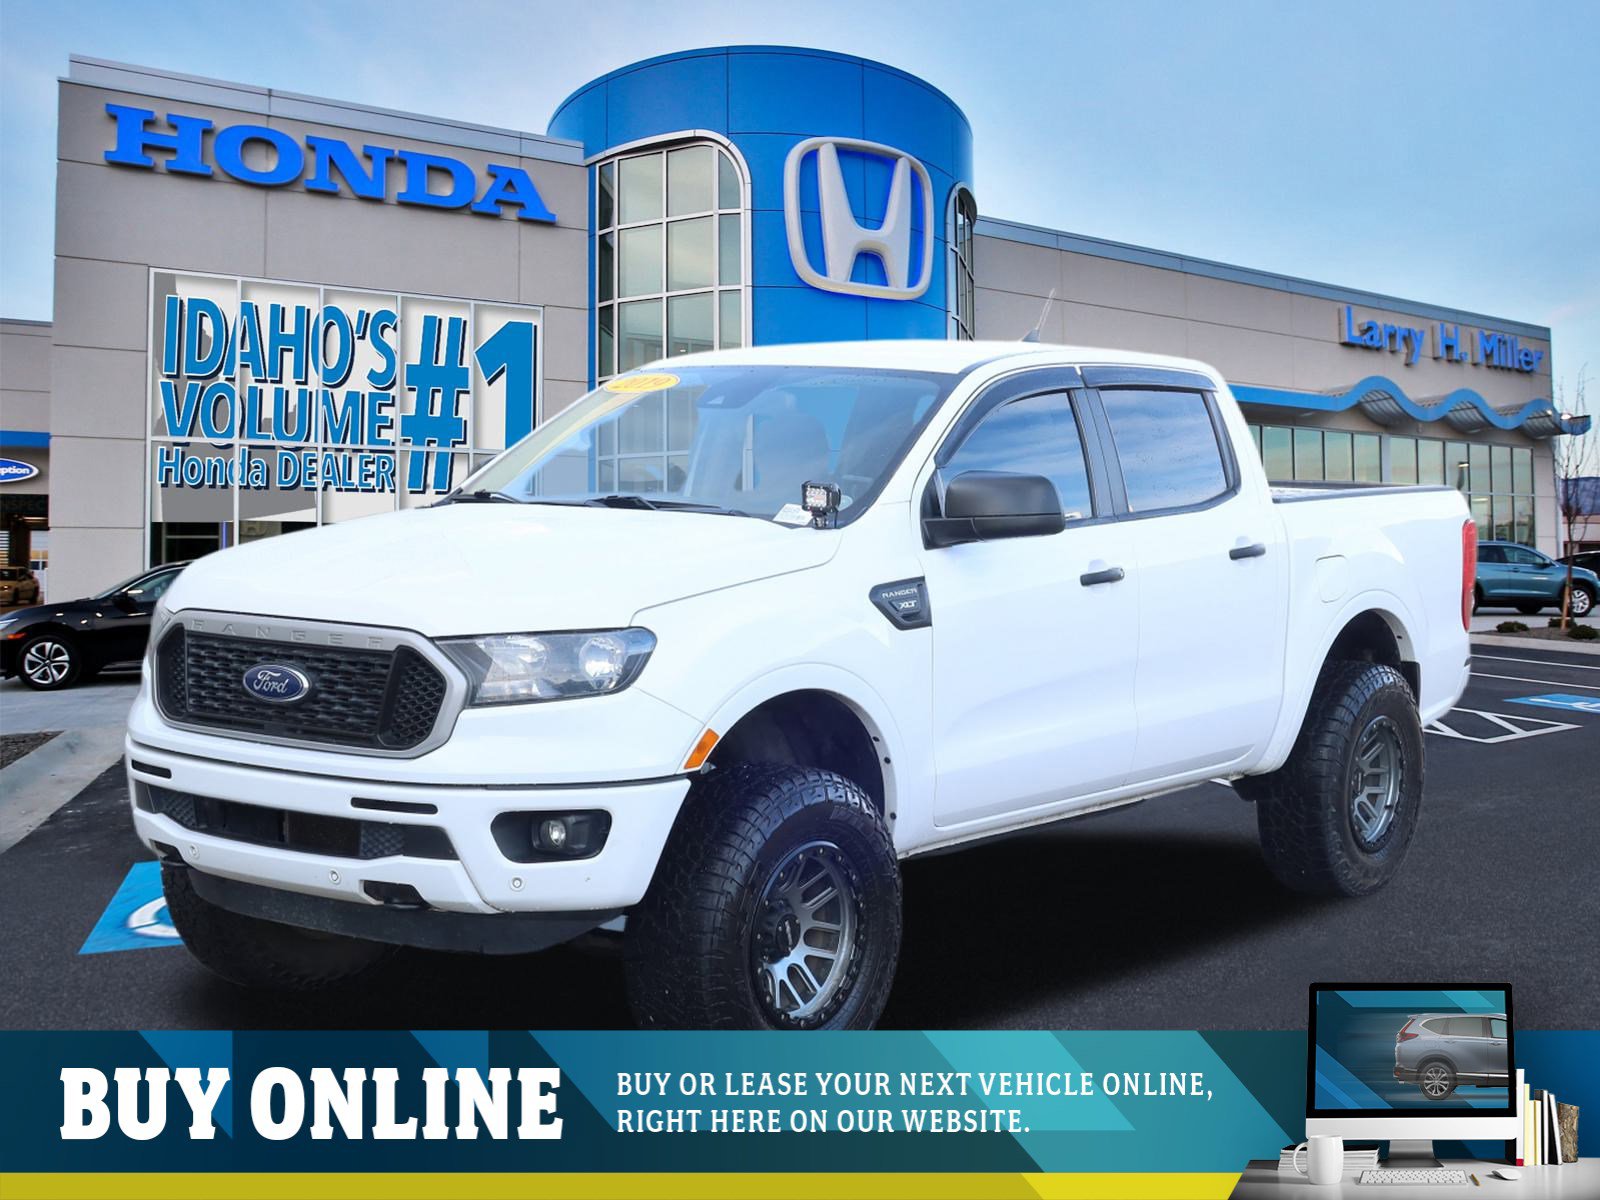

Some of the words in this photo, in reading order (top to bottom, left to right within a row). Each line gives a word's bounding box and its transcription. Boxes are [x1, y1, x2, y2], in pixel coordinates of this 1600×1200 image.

[104, 103, 557, 223] HONDA
[162, 294, 399, 390] IDAHO'S
[1341, 304, 1424, 366] Larry
[1436, 321, 1468, 363] H.
[1476, 329, 1544, 373] Miller
[159, 380, 396, 449] VOLUME
[401, 314, 539, 494] #1
[0, 465, 30, 476] ption
[157, 446, 267, 488] Honda
[275, 450, 396, 489] DEALER
[882, 588, 917, 598] RANGER
[191, 619, 383, 648] RANGER
[253, 670, 289, 693] Ford
